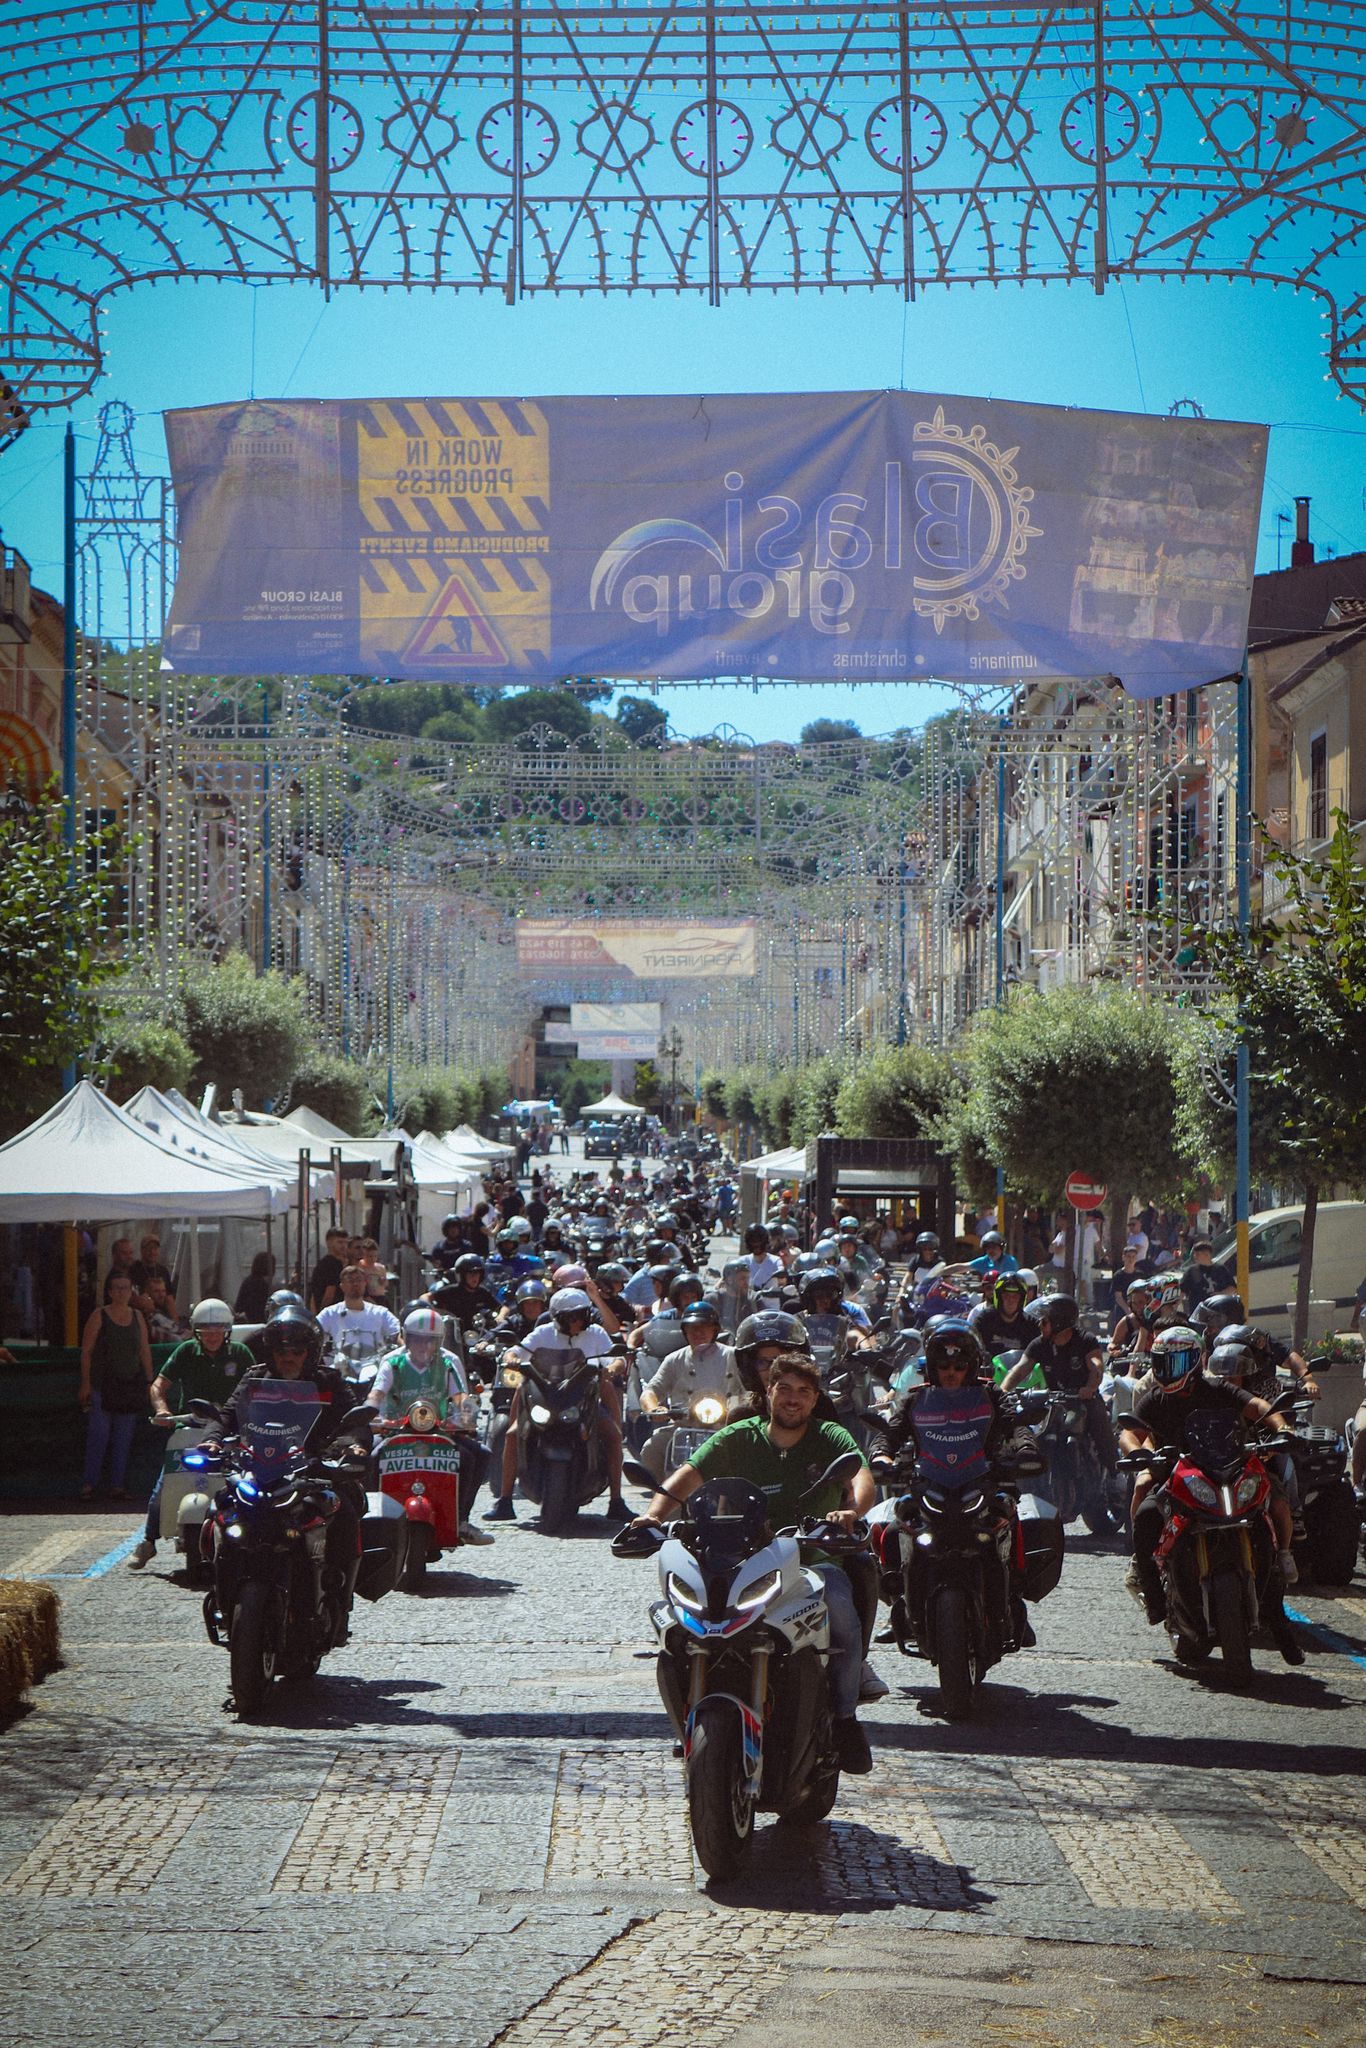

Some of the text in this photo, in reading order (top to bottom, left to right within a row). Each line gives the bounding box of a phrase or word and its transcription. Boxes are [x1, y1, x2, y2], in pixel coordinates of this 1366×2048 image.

[247, 1422, 302, 1436] CARABINIERI
[925, 1429, 979, 1443] CARABINIERI
[385, 1448, 460, 1458] VESPA CLUB
[386, 1459, 459, 1473] AVELLINO
[783, 1601, 820, 1625] S1000
